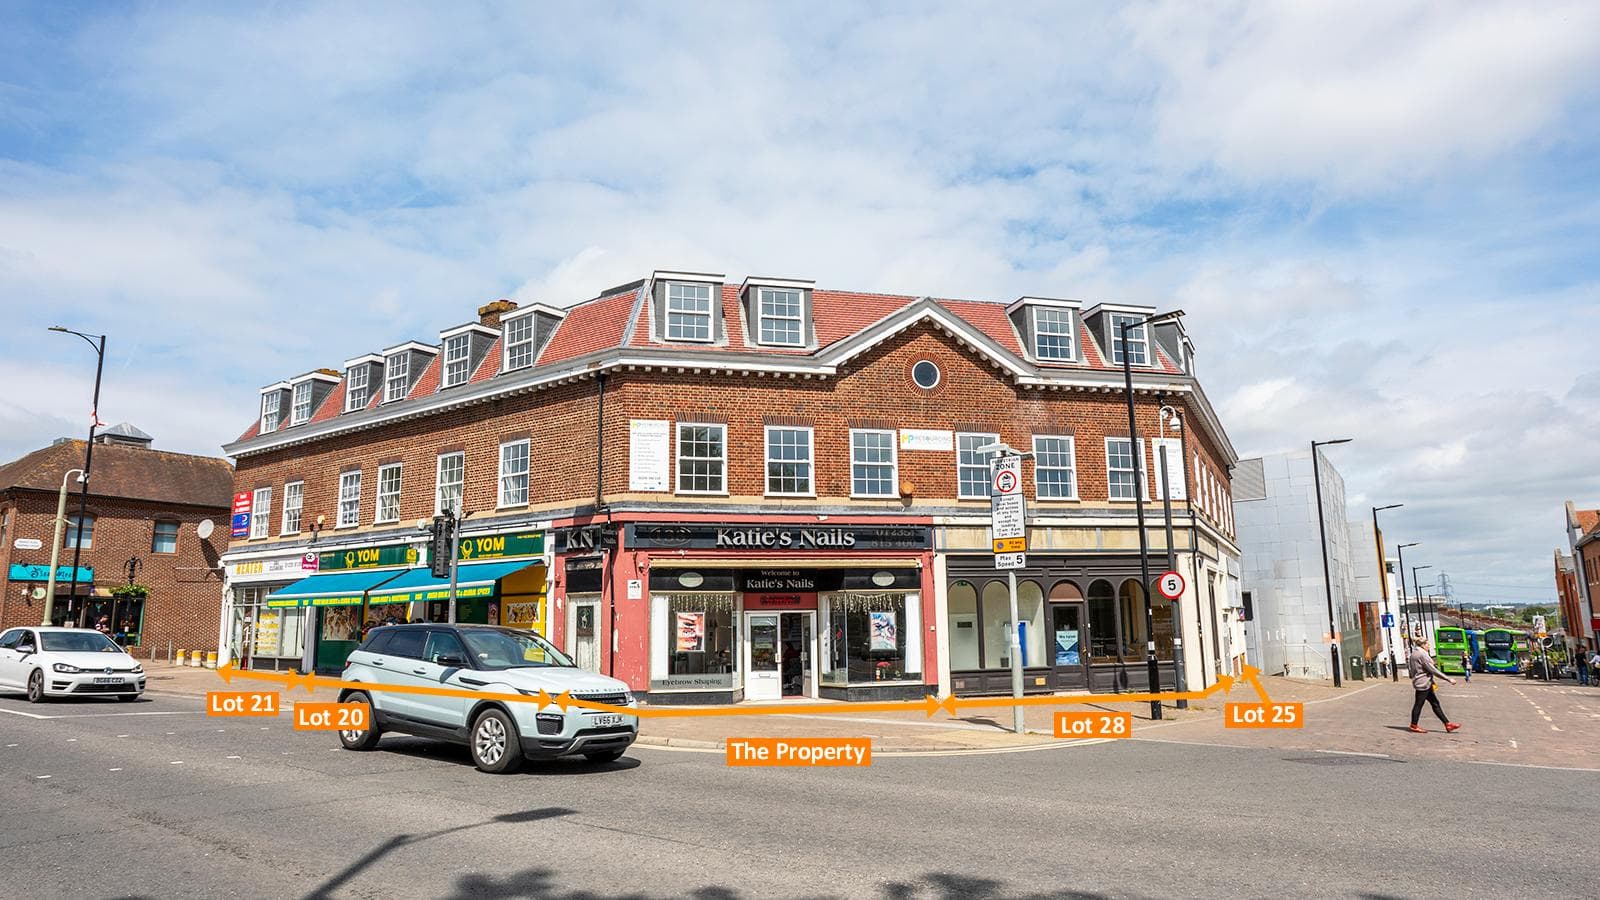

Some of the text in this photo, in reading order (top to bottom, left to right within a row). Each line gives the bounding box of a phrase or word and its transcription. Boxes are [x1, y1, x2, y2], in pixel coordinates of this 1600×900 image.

[566, 530, 594, 549] KN
[716, 528, 792, 547] Katie's
[798, 528, 855, 547] Nails
[476, 536, 505, 552] YOM
[357, 549, 379, 562] YOM
[1016, 554, 1023, 564] 5
[746, 578, 814, 589] Katie's Nails
[1168, 579, 1176, 591] 5
[662, 678, 722, 687] Eyebrow Shaping
